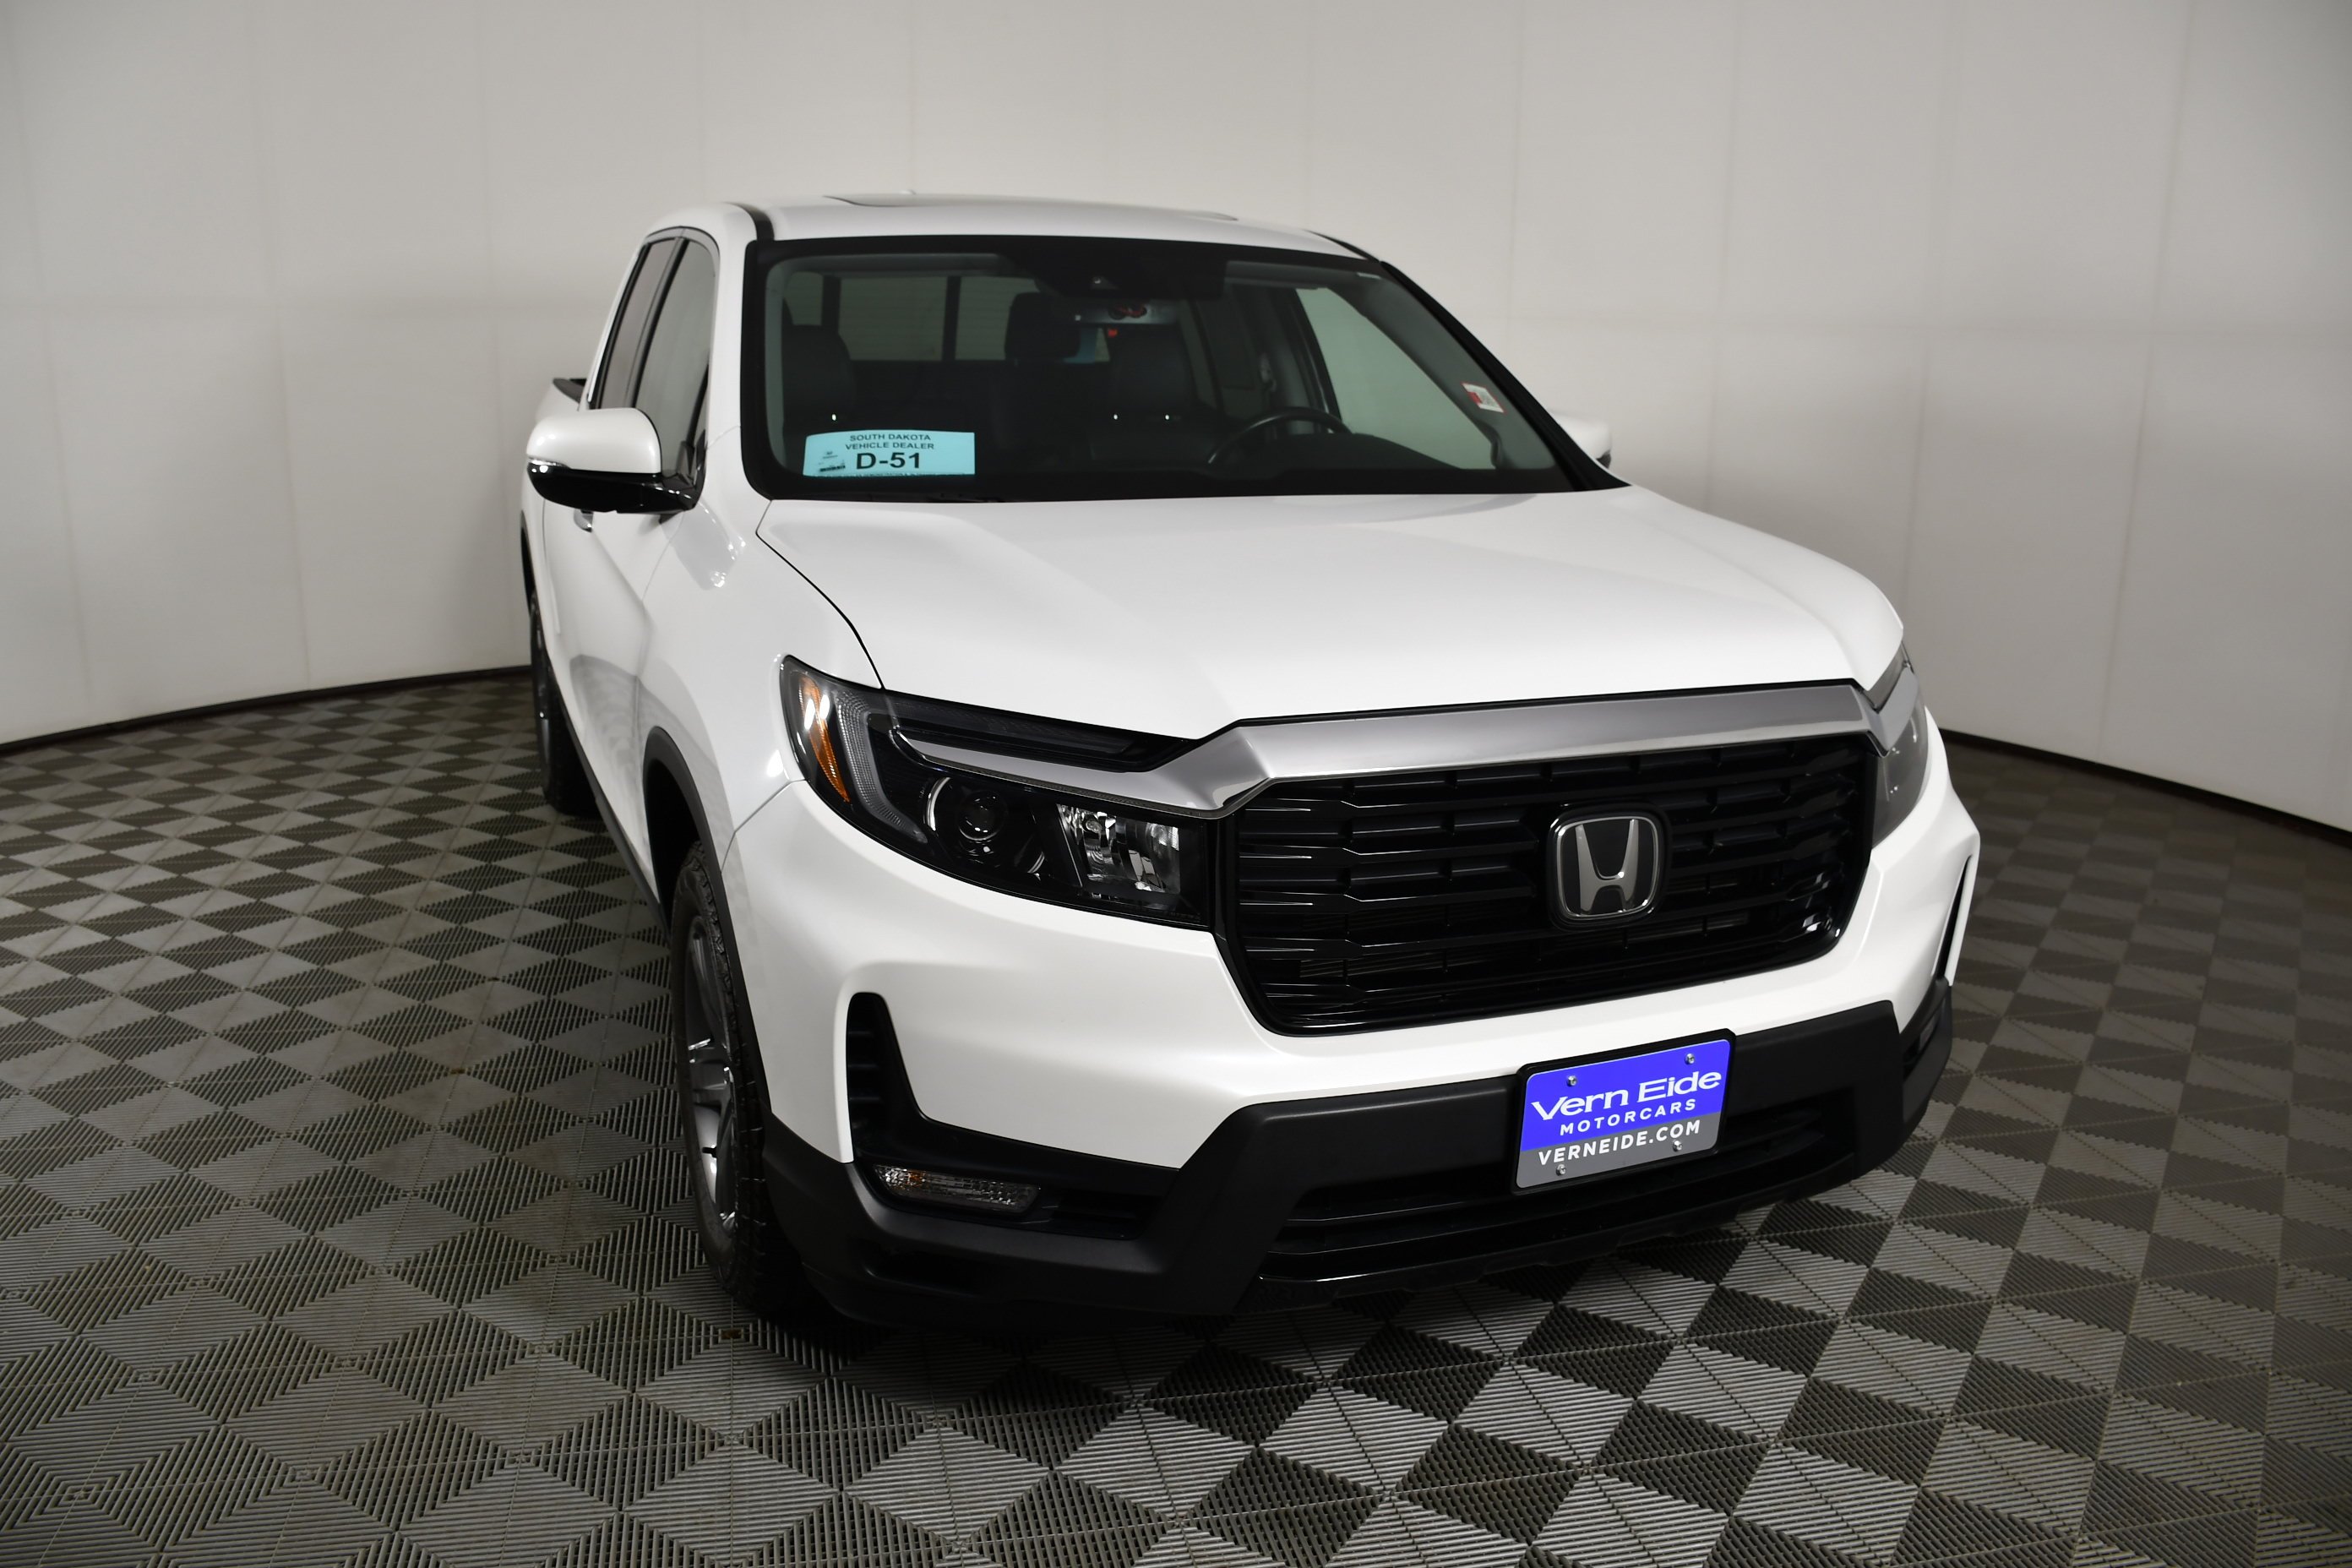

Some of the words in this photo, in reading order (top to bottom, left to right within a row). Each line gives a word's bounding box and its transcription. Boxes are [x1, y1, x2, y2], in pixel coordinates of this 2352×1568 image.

[845, 442, 888, 450] VEHICLE
[849, 433, 885, 442] SOUTH
[856, 452, 920, 470] D-51
[1531, 1088, 1629, 1121] Vern
[1636, 1070, 1722, 1103] Eide
[1560, 1098, 1696, 1136] MOTORCARS
[1538, 1119, 1701, 1166] VERNEIDE.COM
